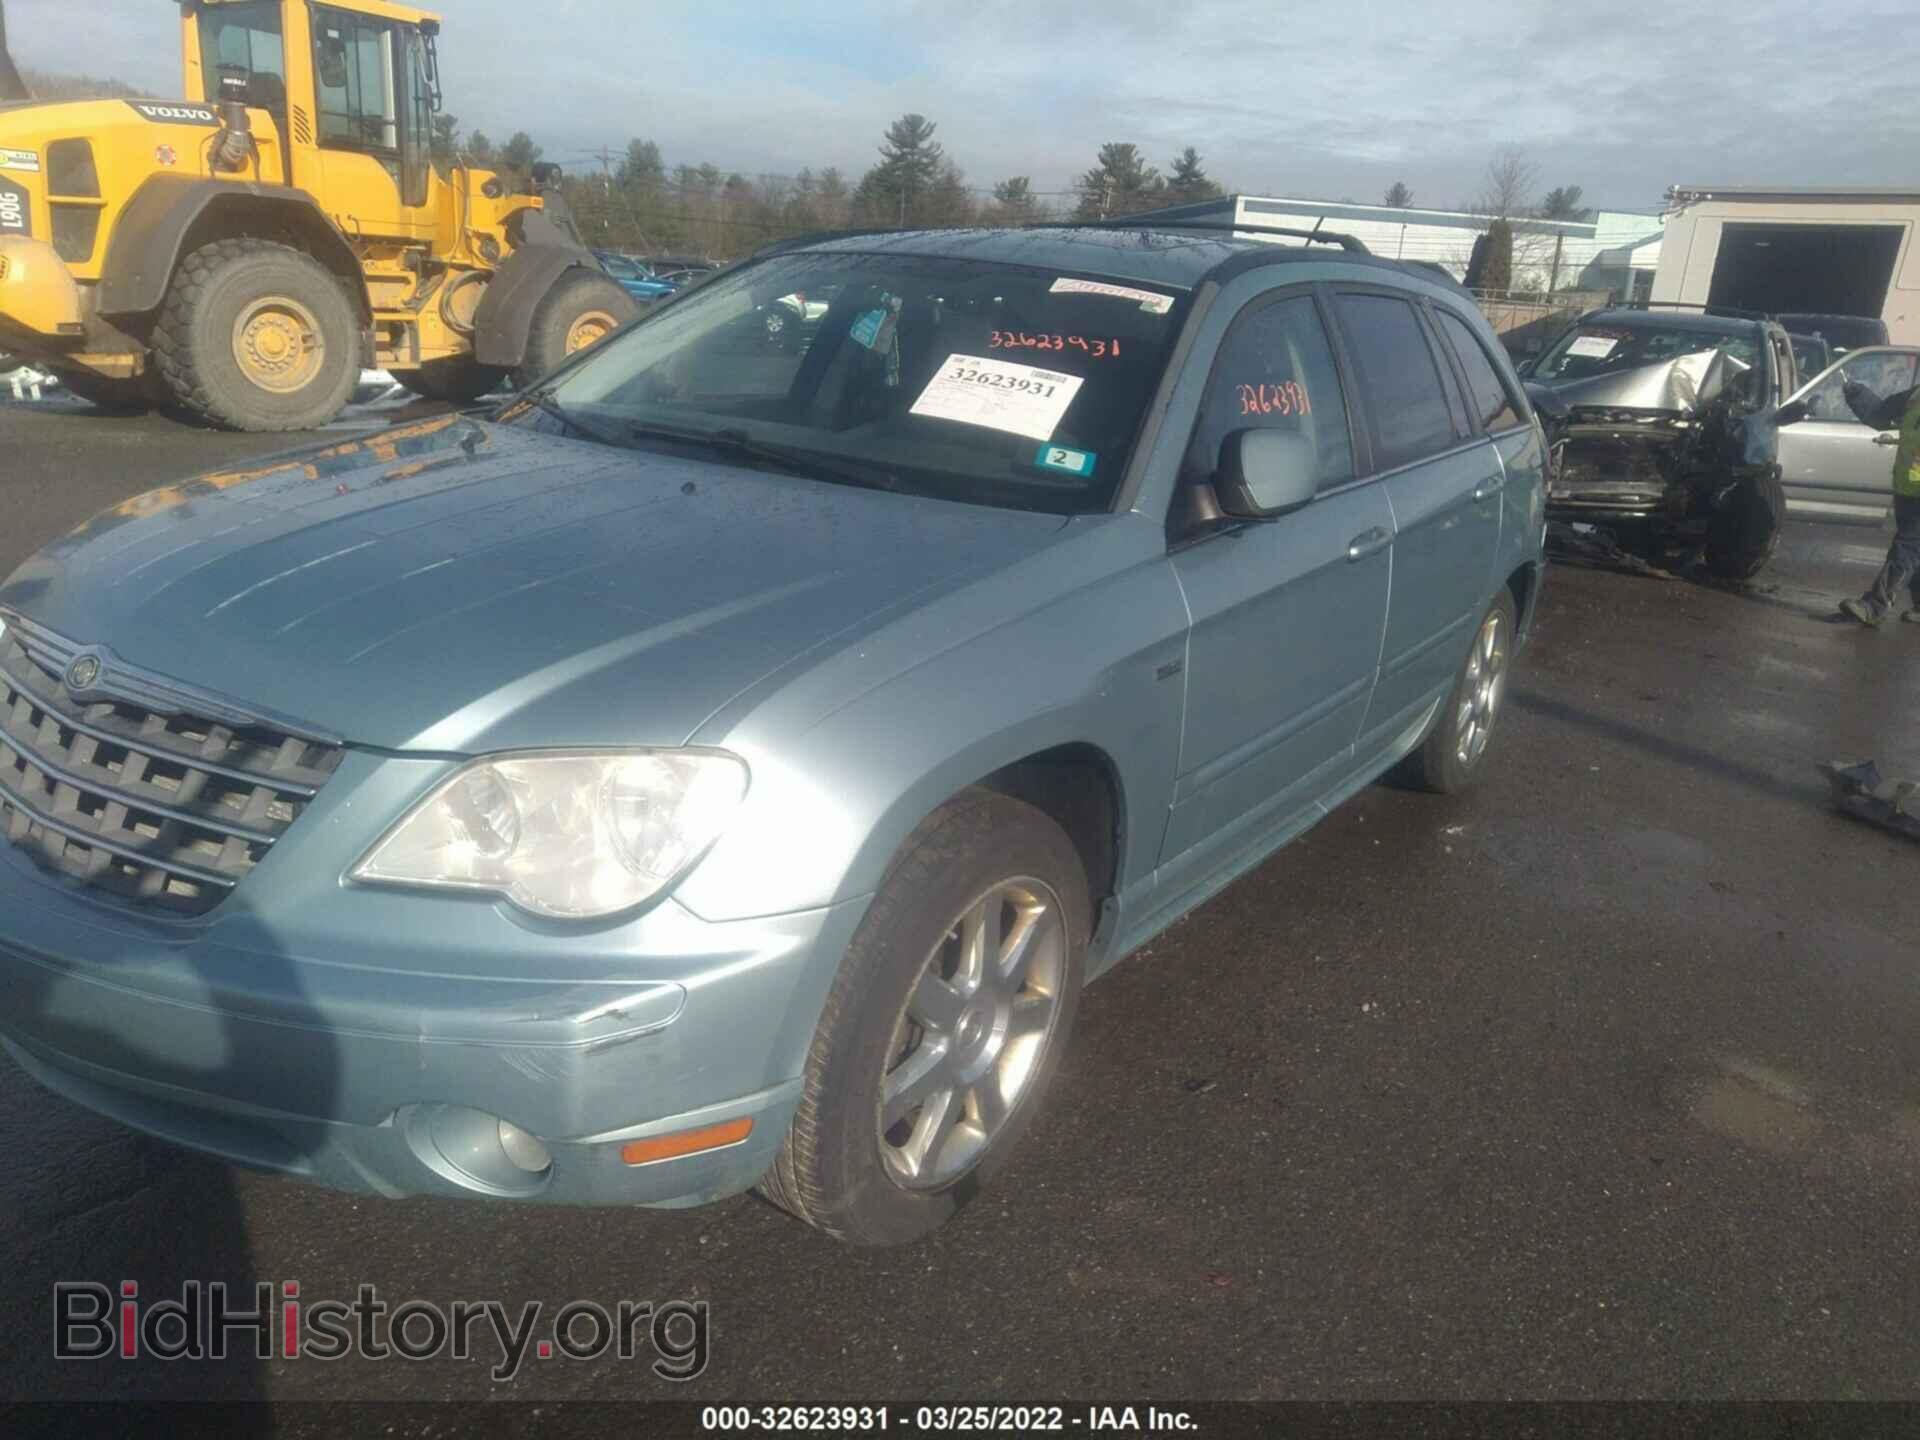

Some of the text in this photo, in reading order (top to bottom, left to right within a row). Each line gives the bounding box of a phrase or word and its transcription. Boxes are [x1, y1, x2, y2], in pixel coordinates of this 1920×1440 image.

[139, 105, 213, 120] VOLVO
[0, 191, 23, 229] L90G
[989, 330, 1121, 357] 32623931
[949, 367, 1056, 398] 32623931
[1235, 380, 1311, 415] 32623931
[1053, 450, 1067, 464] 2
